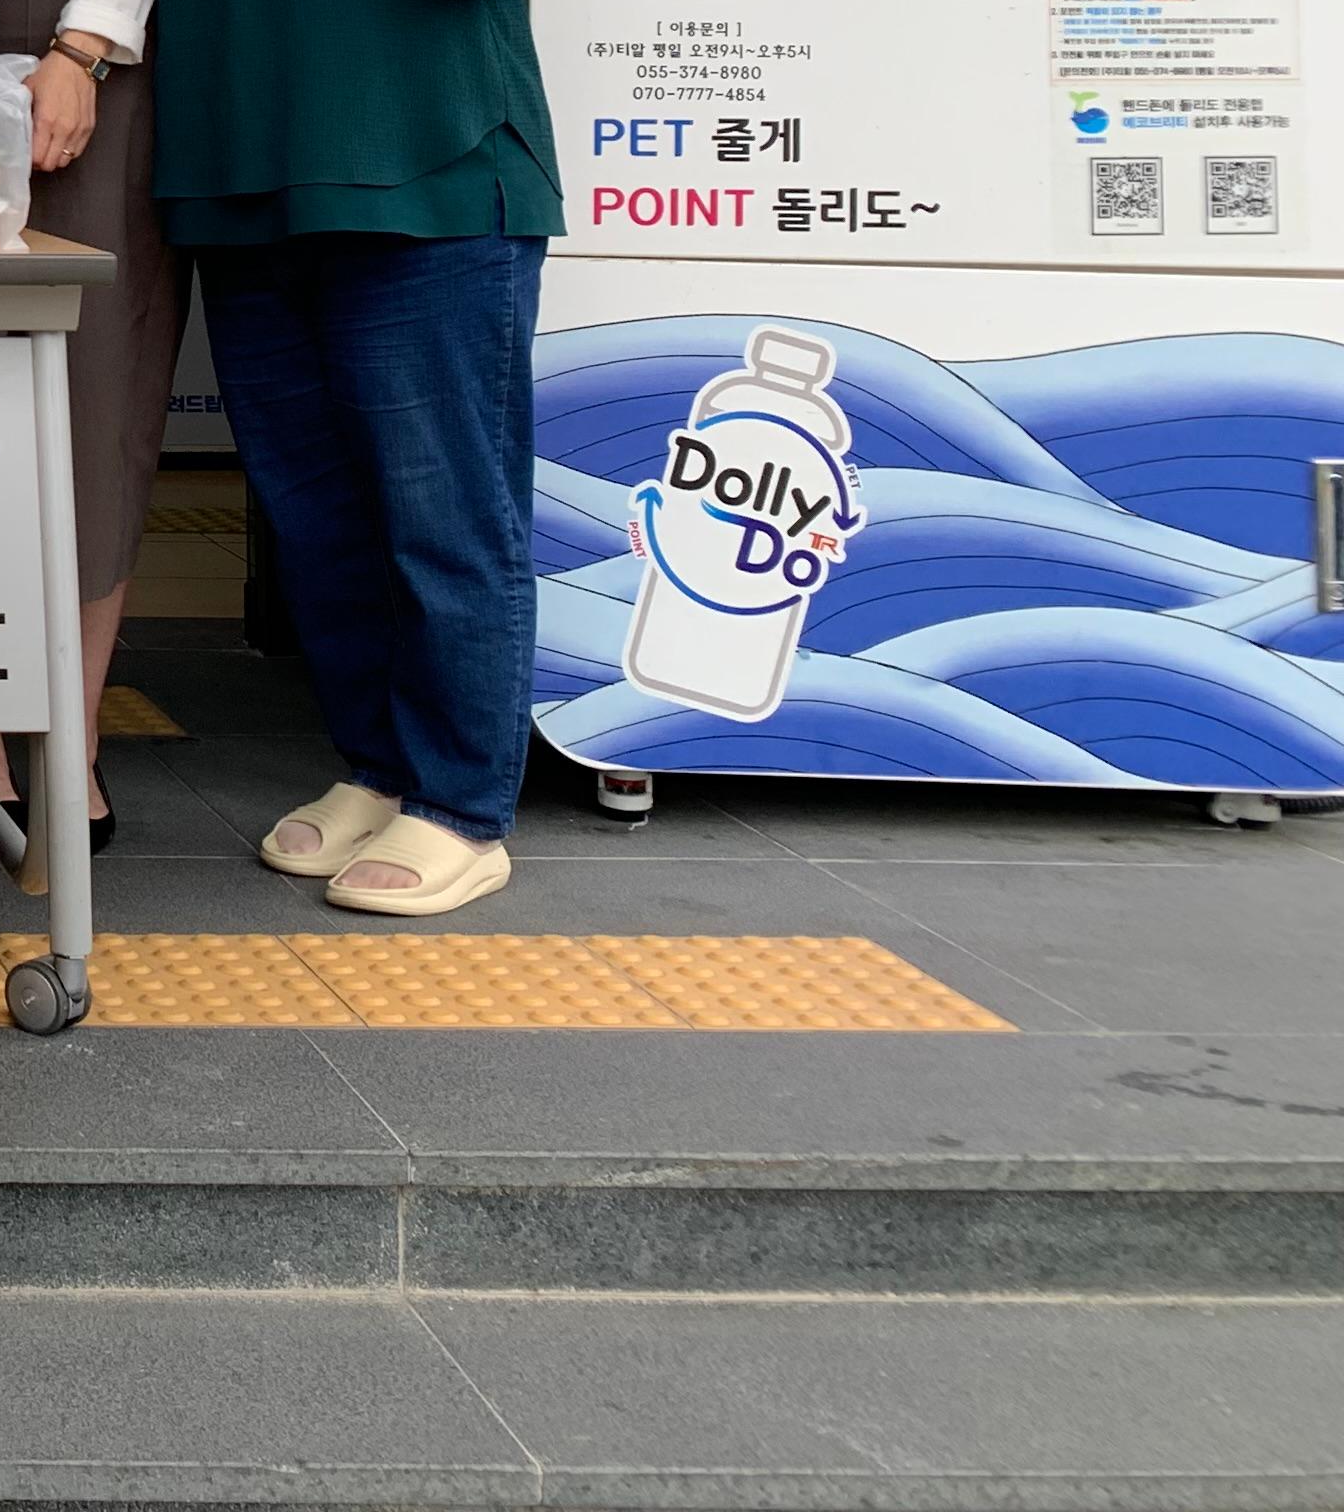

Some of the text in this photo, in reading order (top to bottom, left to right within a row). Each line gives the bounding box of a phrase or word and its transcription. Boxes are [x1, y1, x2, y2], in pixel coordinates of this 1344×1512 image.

[653, 44, 681, 58] 평일
[636, 65, 762, 80] 055-374-8980
[633, 87, 766, 101] 070-7777-4854
[593, 118, 800, 163] PET 줄게
[592, 188, 755, 227] POINT
[670, 436, 831, 537] Dolly
[845, 466, 862, 489] PET
[628, 521, 646, 559] POINT
[715, 505, 822, 588] Do
